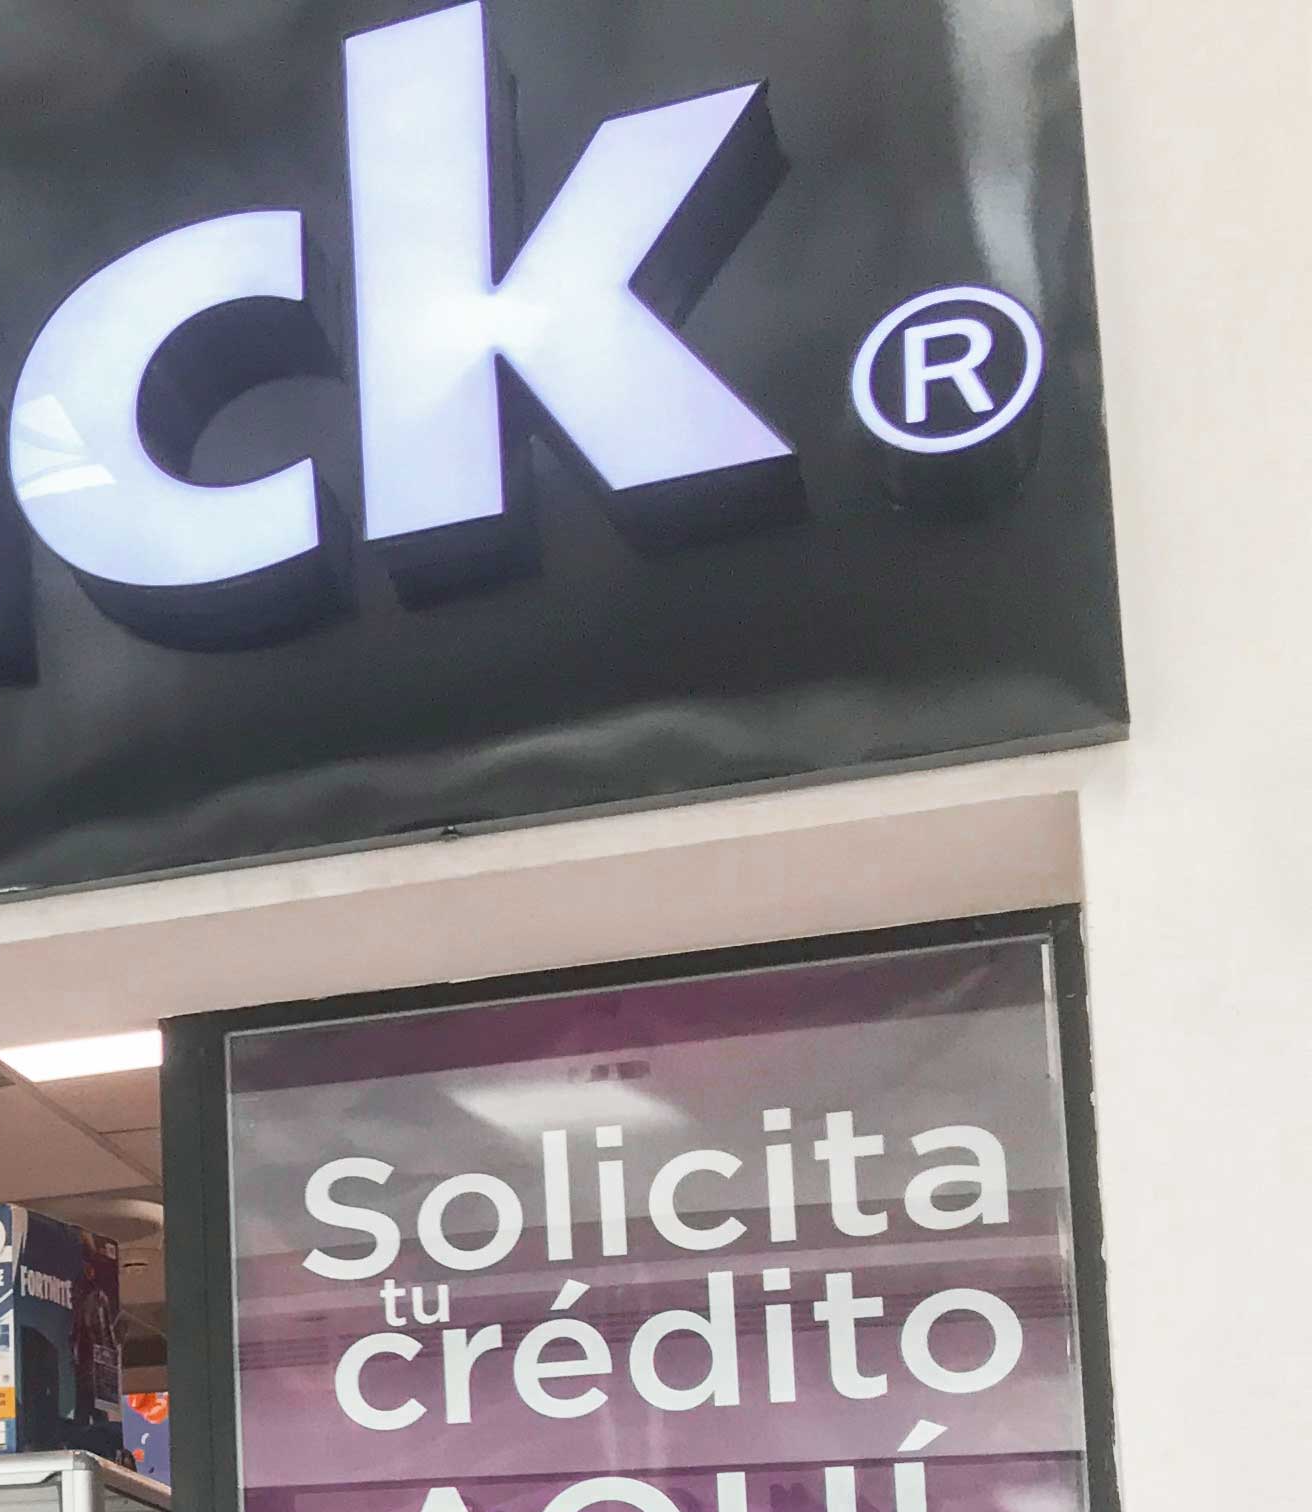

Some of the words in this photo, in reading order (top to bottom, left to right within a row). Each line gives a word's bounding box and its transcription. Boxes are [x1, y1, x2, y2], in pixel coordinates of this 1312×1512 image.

[302, 1107, 1012, 1281] Solicita
[19, 1264, 74, 1310] FORTNITE
[380, 1278, 451, 1328] tu
[334, 1266, 1024, 1431] crédito
